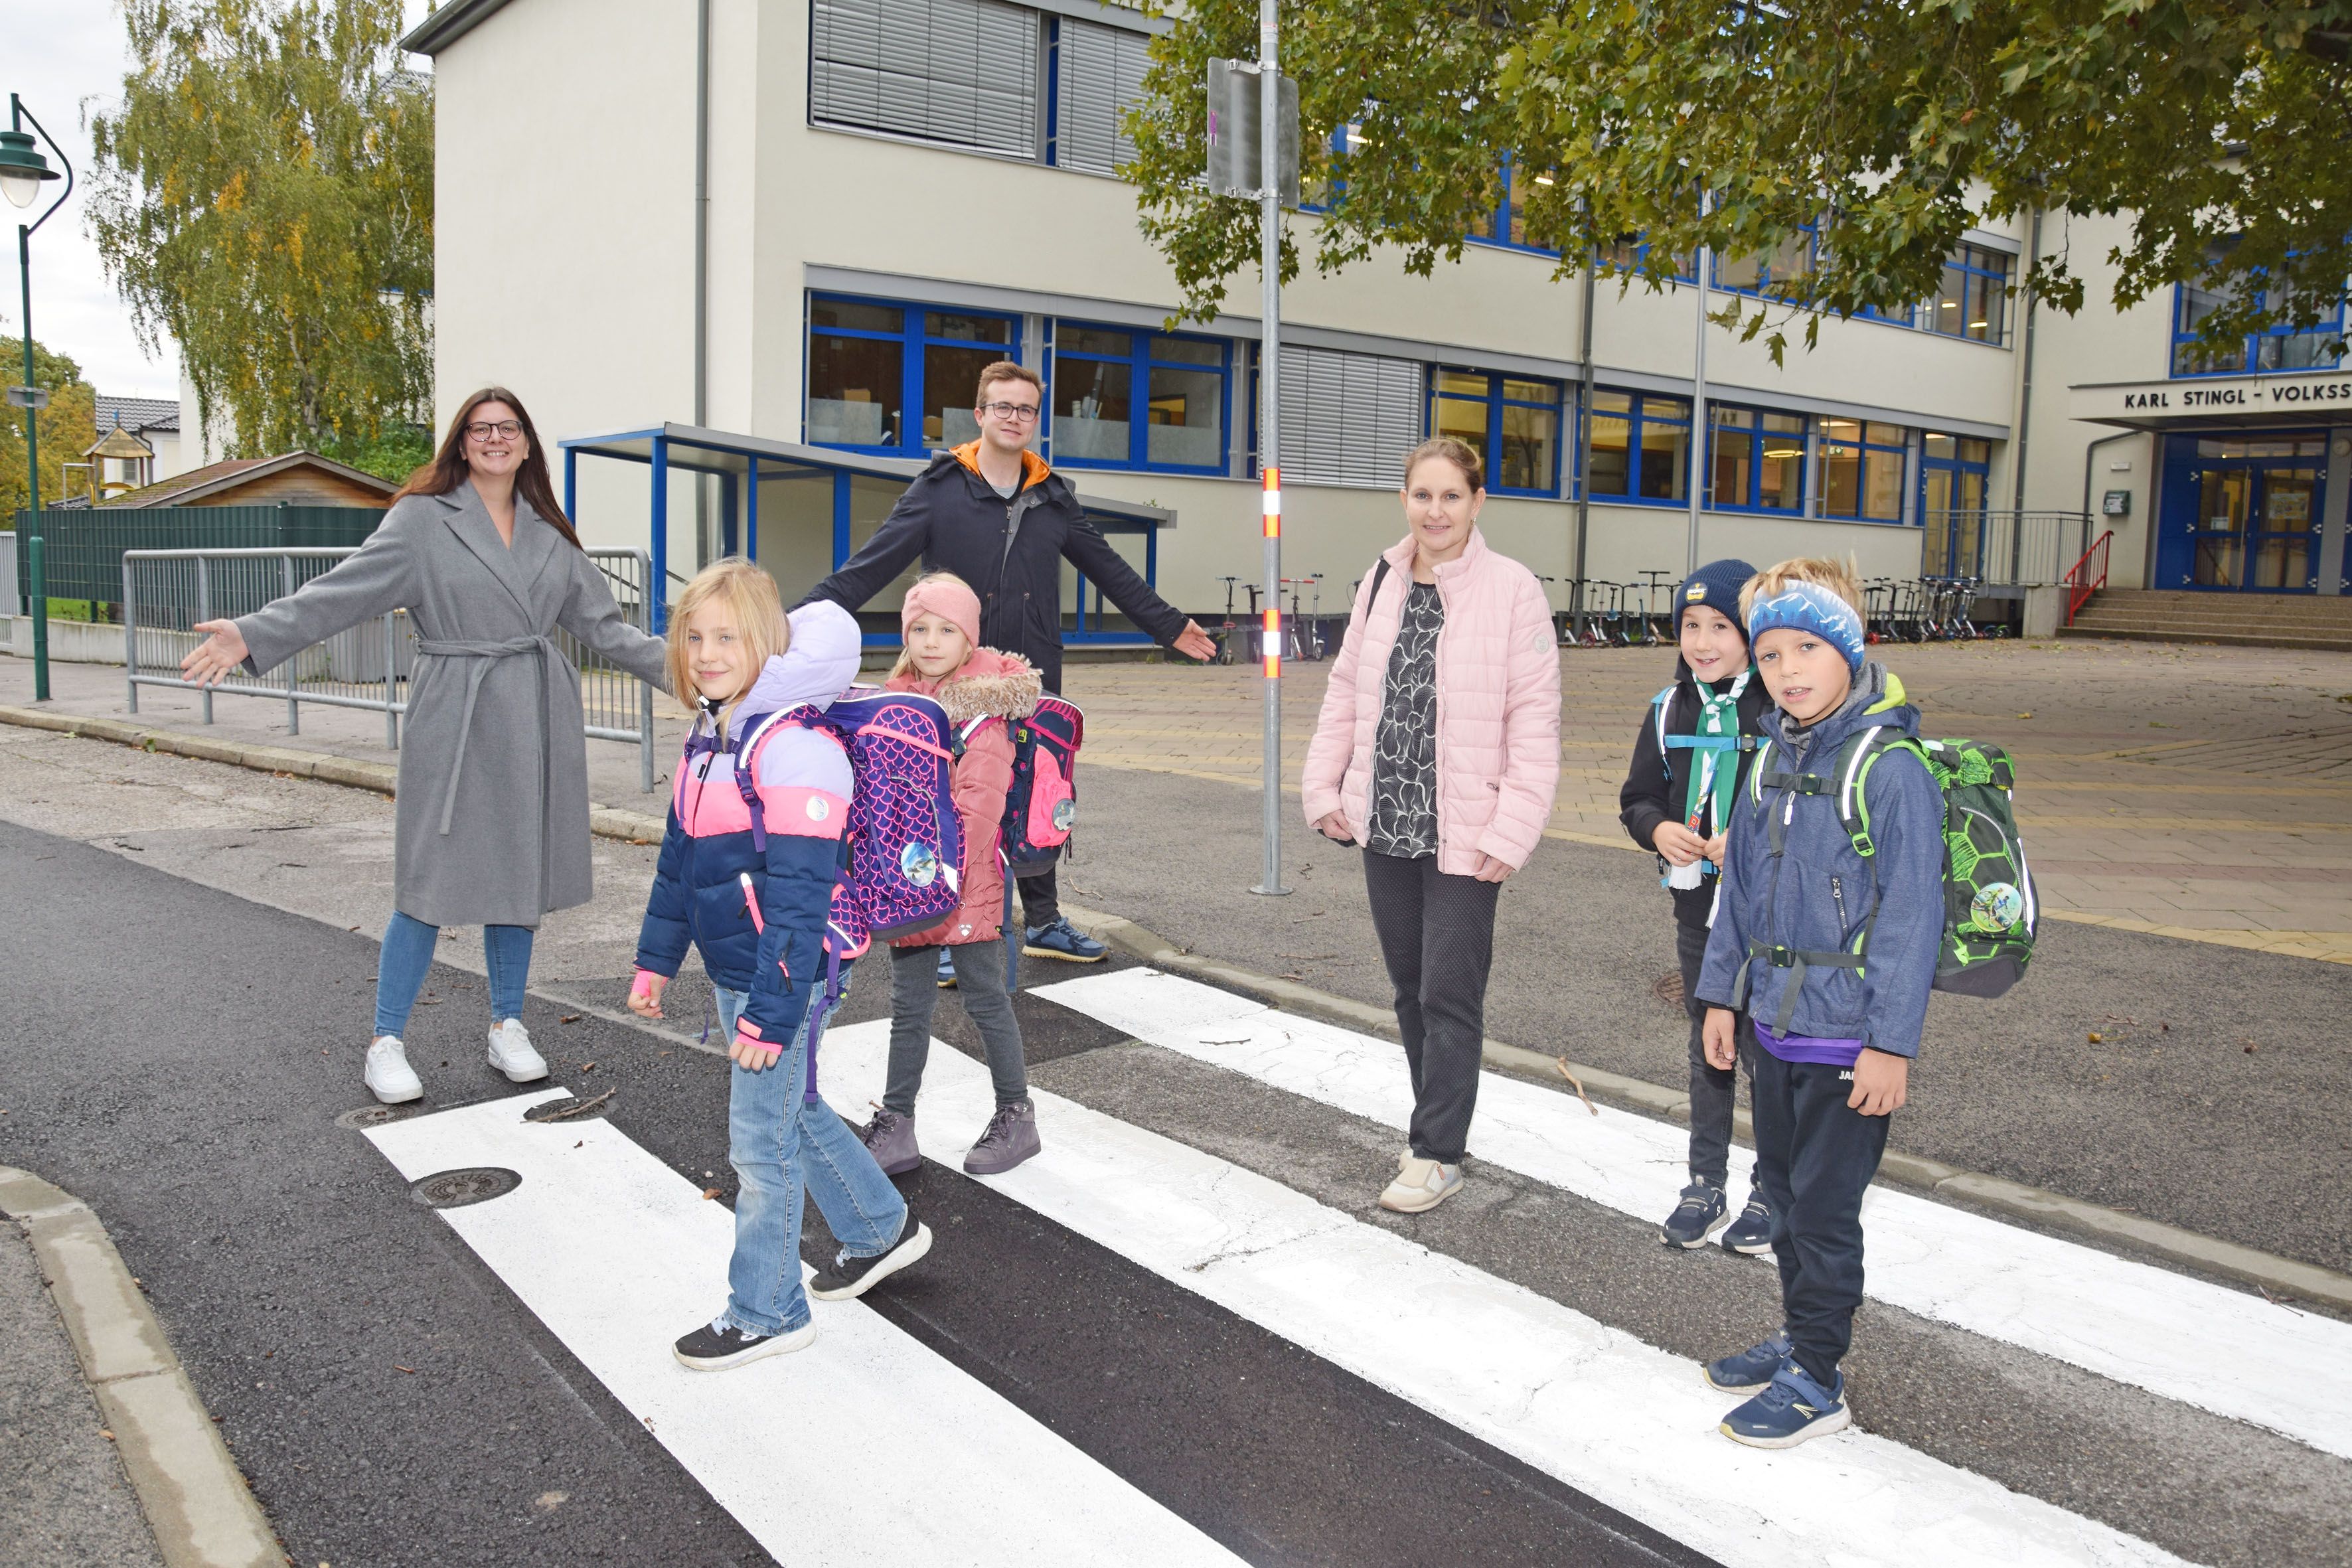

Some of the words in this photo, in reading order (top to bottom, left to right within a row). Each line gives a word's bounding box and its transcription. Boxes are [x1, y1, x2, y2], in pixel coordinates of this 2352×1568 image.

[2125, 393, 2169, 408] KARL
[2183, 389, 2246, 406] STINGL
[2272, 383, 2351, 402] VOLKSS
